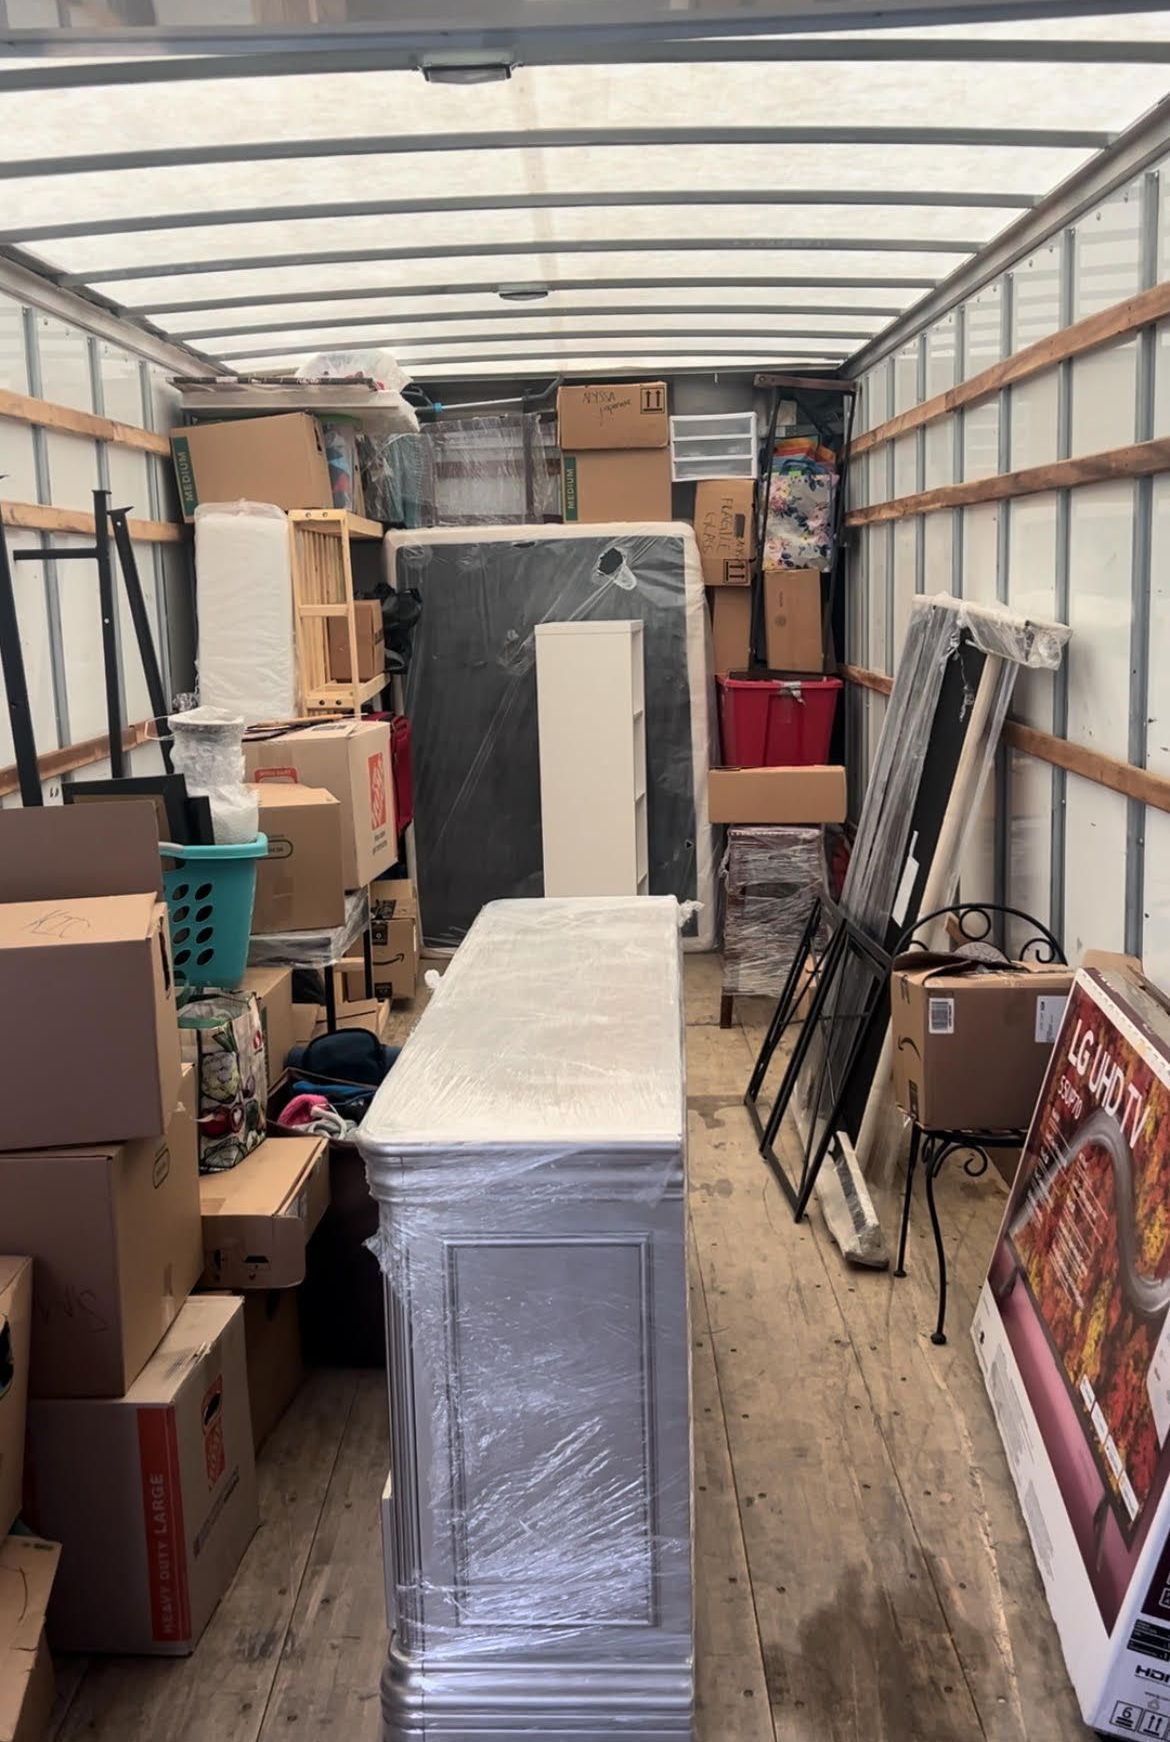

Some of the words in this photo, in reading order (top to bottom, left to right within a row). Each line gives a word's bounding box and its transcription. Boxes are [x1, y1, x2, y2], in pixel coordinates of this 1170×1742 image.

[177, 452, 193, 501] MEDIUM
[1068, 1018, 1094, 1076] LG
[1088, 1044, 1124, 1117] UHD
[1120, 1083, 1151, 1149] TV
[149, 1472, 167, 1534] LARGE
[157, 1541, 170, 1580] DUTY
[160, 1586, 174, 1634] HEAVY
[1122, 1706, 1133, 1718] 6
